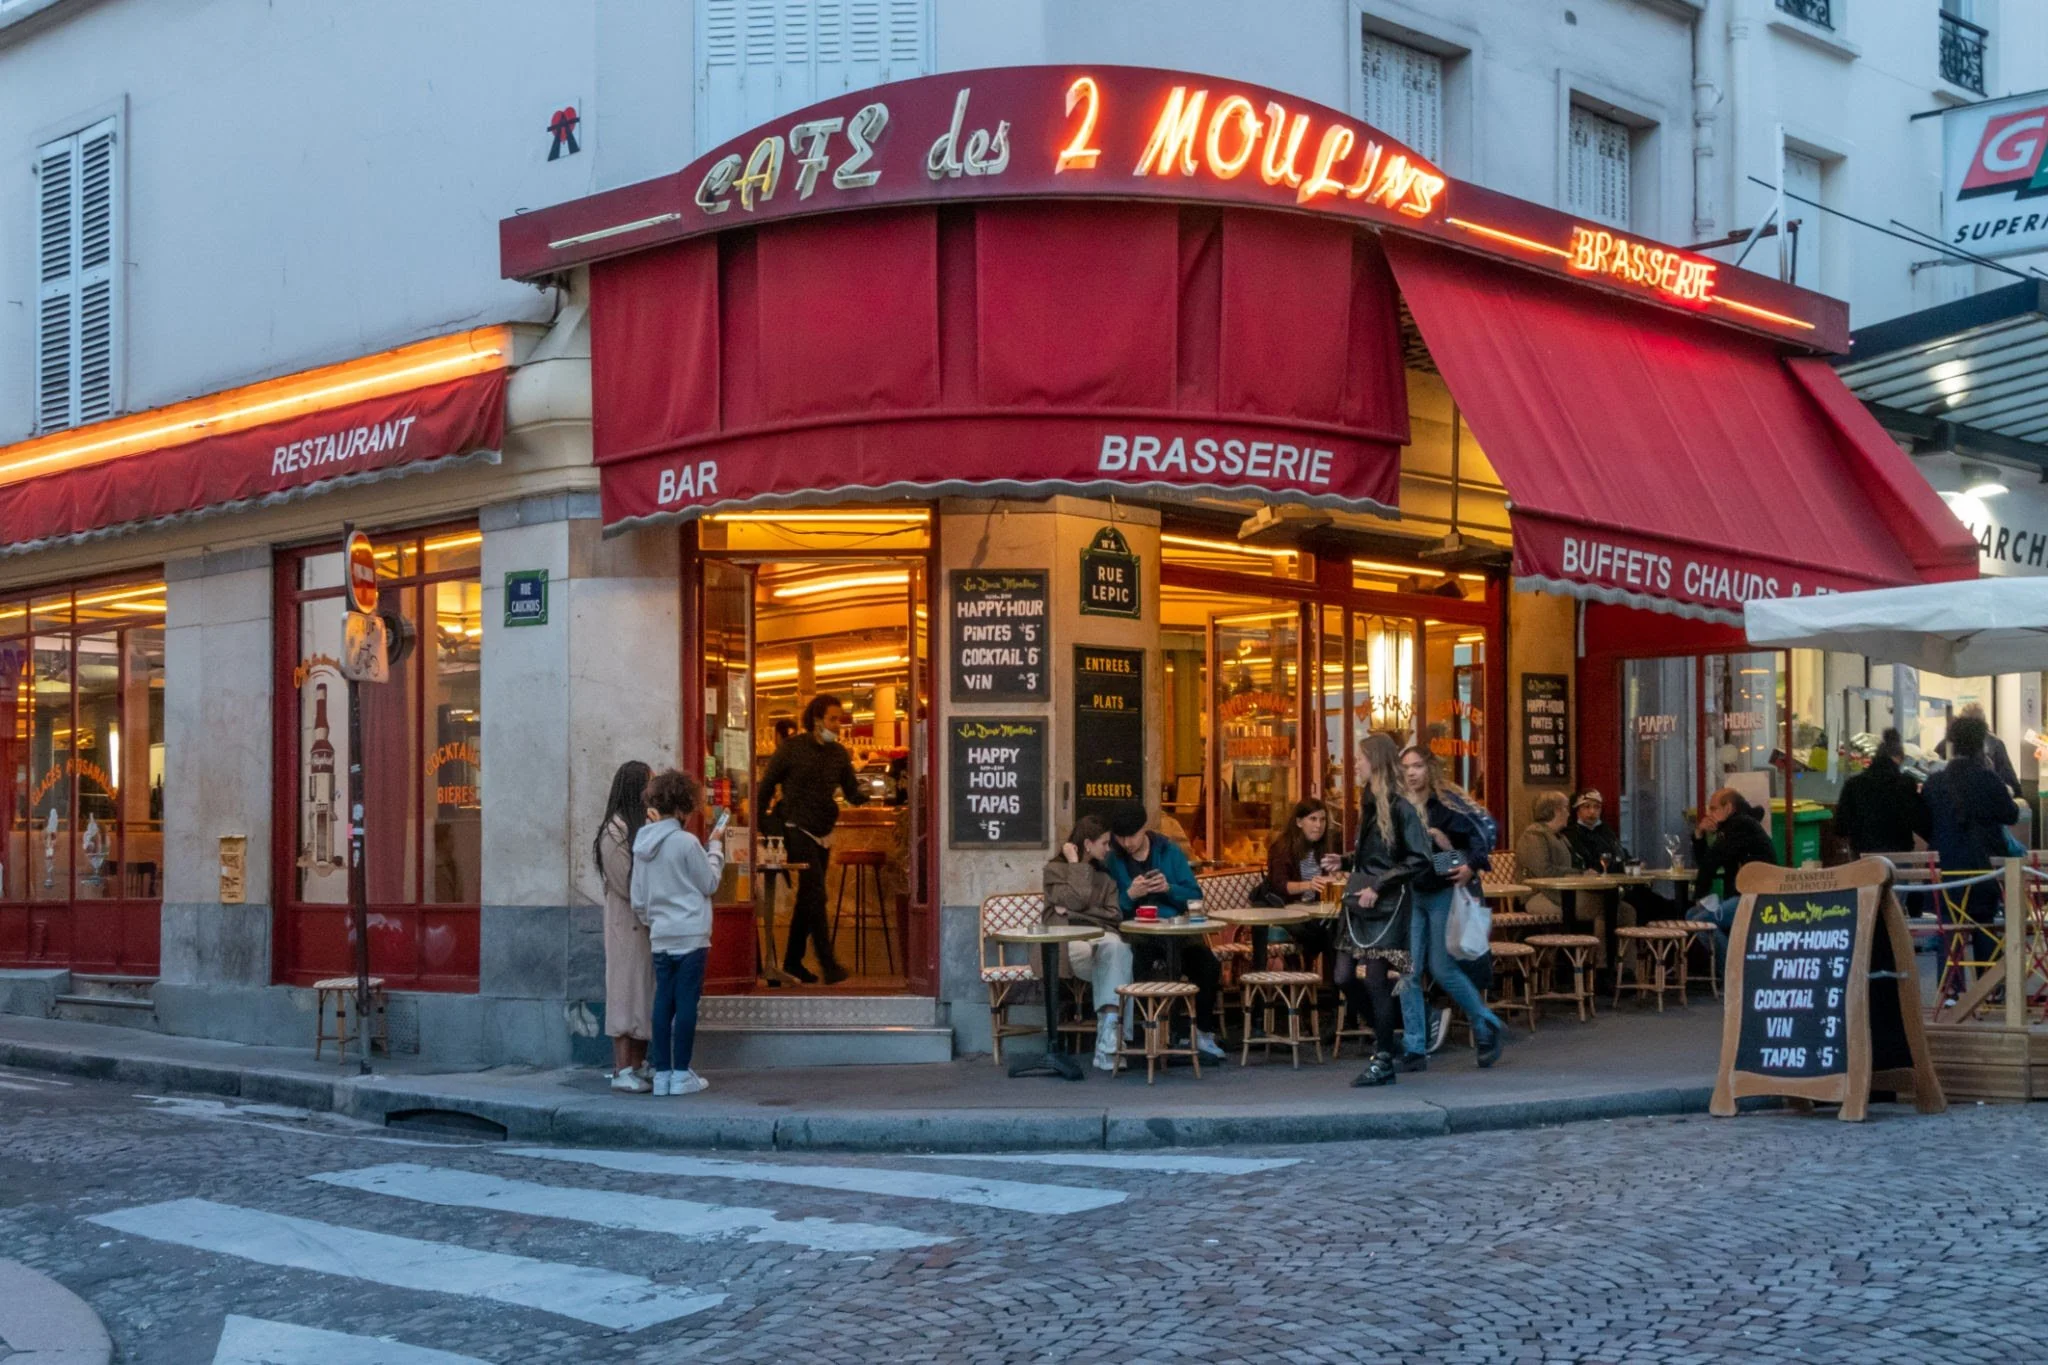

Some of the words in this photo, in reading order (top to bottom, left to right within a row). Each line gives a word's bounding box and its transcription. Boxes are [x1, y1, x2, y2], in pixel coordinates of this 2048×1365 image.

[927, 88, 1010, 180] des
[1055, 77, 1101, 175] 2
[1133, 86, 1445, 218] MOULINS
[1572, 226, 1717, 302] BRASSERIE
[271, 416, 416, 476] RESTAURANT
[658, 460, 718, 505] BAR
[1098, 435, 1334, 484] BRASSERIE
[1970, 522, 2048, 568] ARCH
[1562, 537, 1672, 590] BUFFETS
[1097, 565, 1124, 583] RUE
[1092, 584, 1129, 603] LEPIC
[1093, 694, 1124, 710] PLATS
[1638, 714, 1678, 733] HAPPY
[968, 747, 1020, 764] HAPPY
[970, 771, 1018, 788] HOUR
[1086, 783, 1132, 798] DESSERTS
[966, 794, 1020, 814] TAPAS
[1755, 929, 1849, 953] HAPPY-HOURS
[1760, 1047, 1807, 1068] TAPAS
